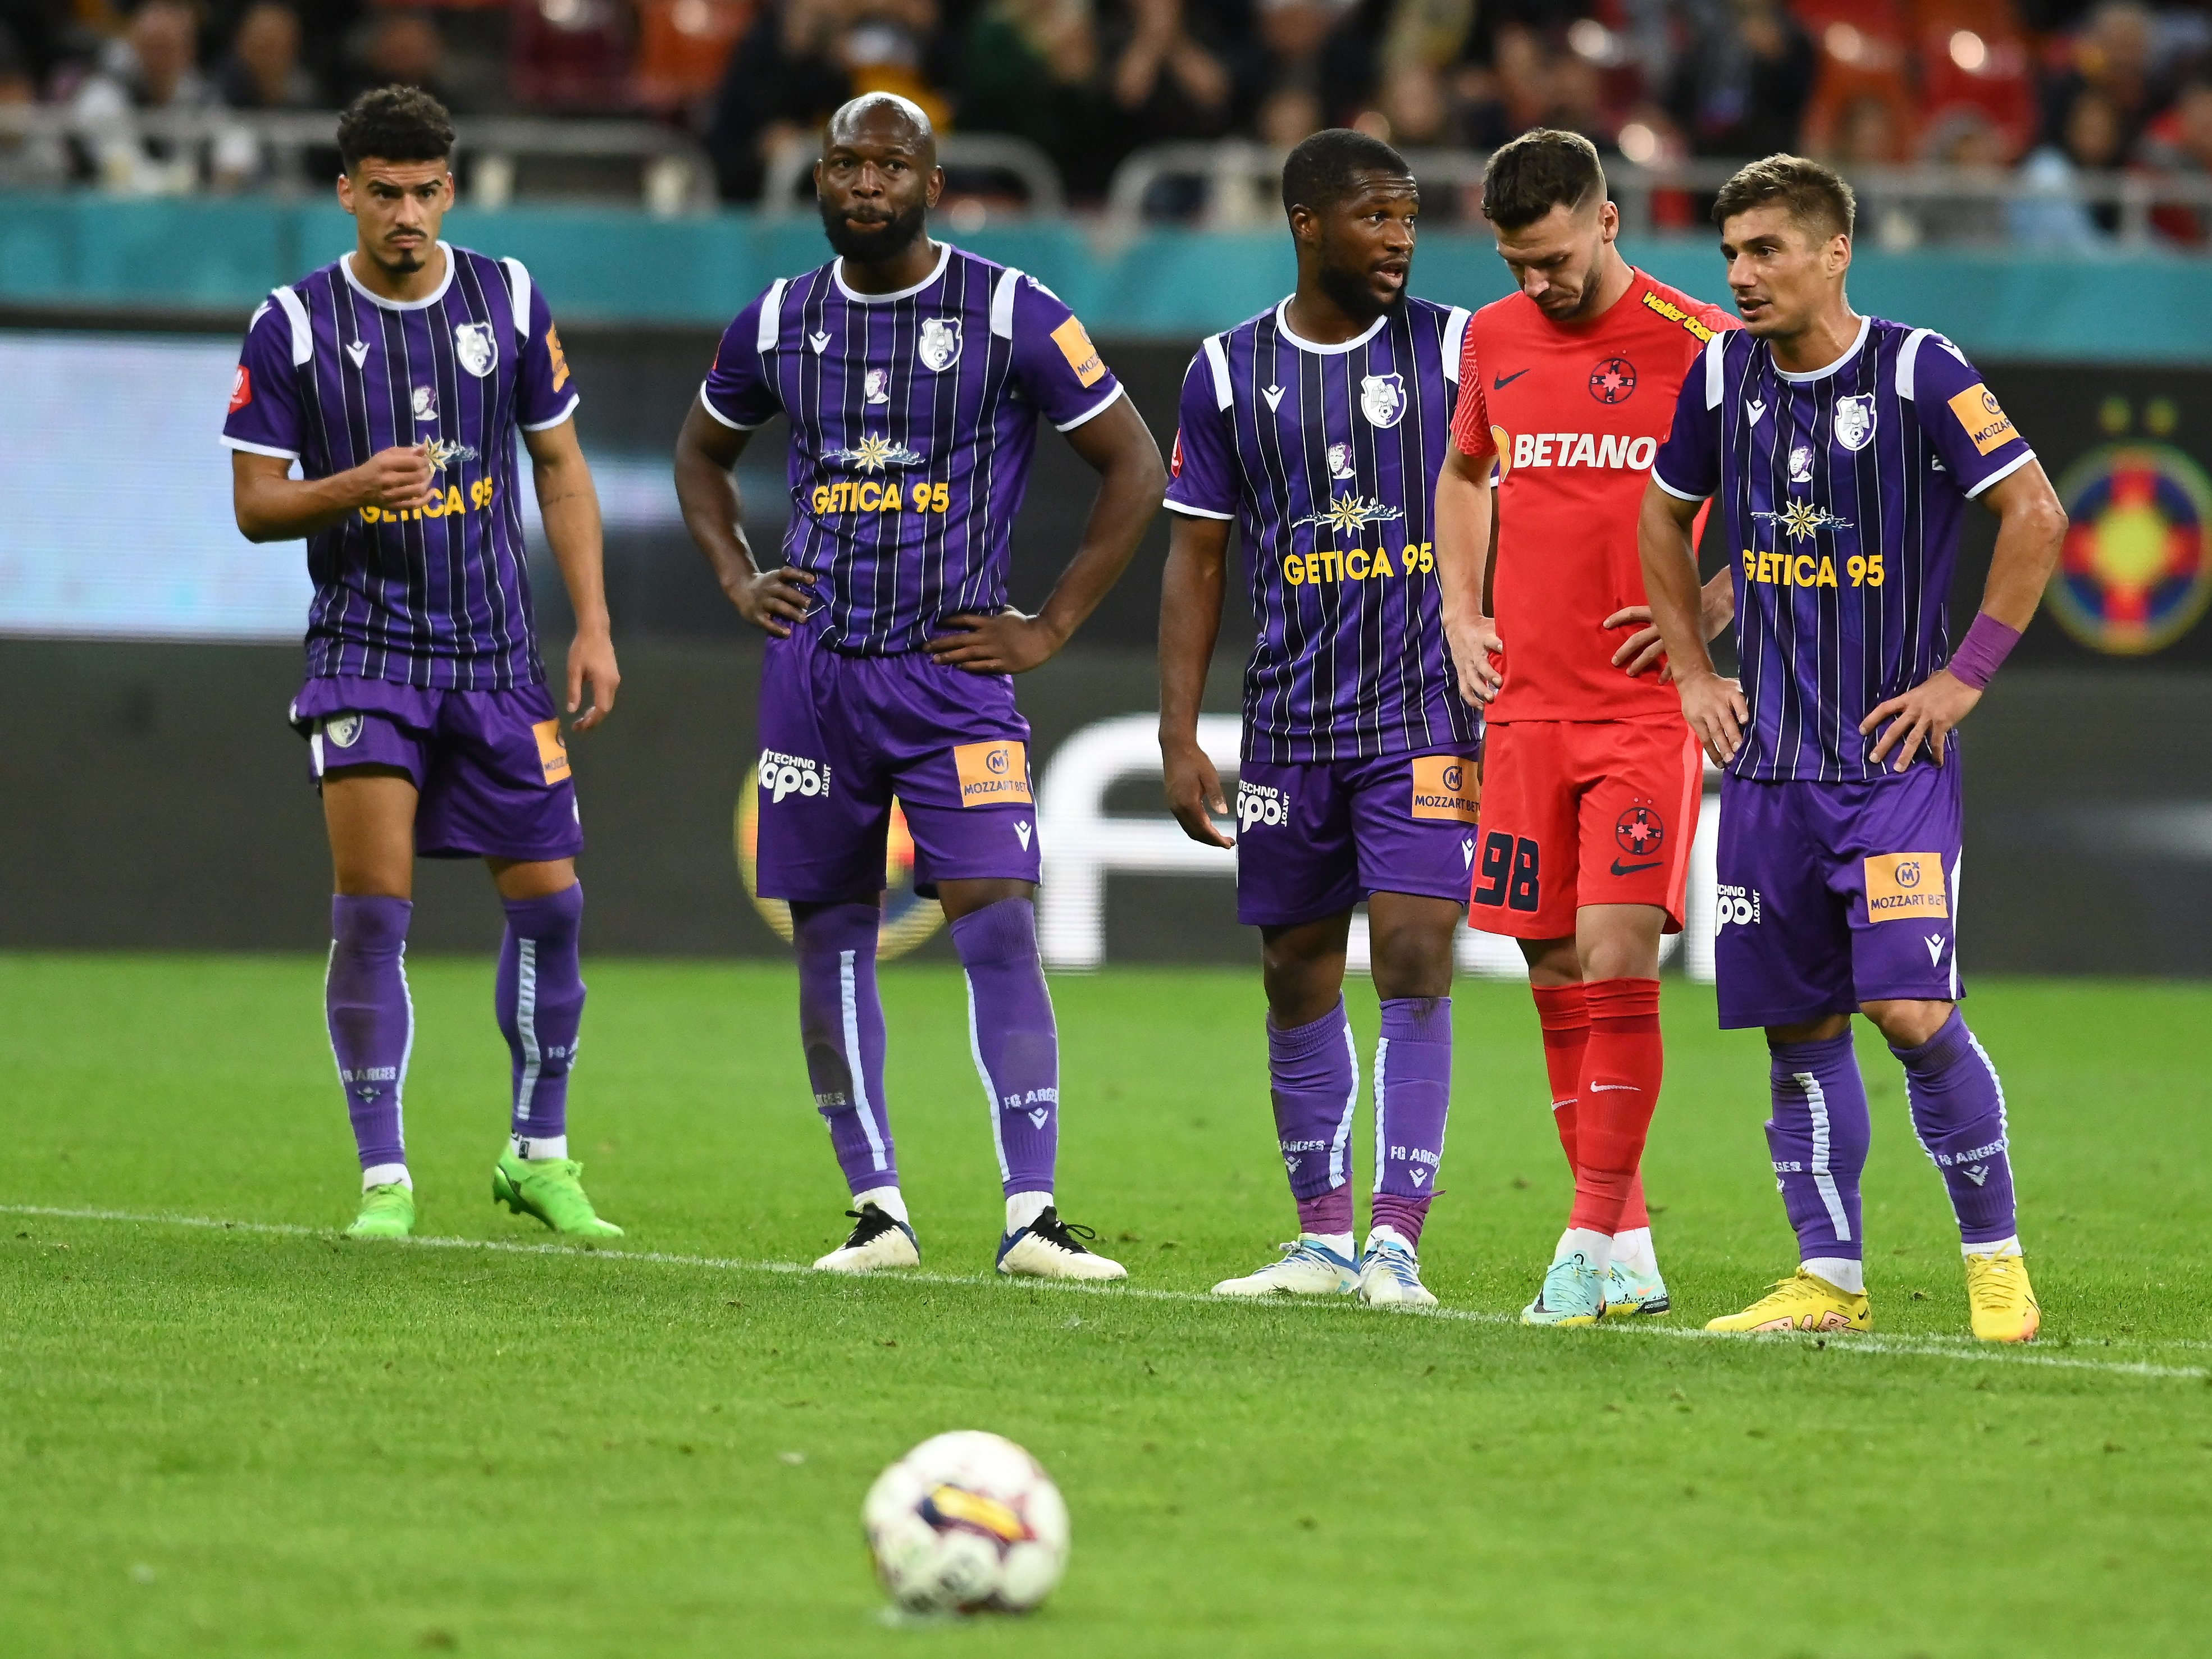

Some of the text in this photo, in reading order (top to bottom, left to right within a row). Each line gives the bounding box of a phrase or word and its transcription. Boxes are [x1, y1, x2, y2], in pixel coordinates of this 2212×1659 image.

[1974, 418, 2012, 444] MOZZAR
[1513, 433, 1657, 470] BETANO
[471, 477, 492, 510] 95
[812, 481, 950, 515] GETICA 95
[1284, 542, 1434, 586] GETICA 95
[1743, 549, 1885, 588] GETICA 95
[768, 751, 816, 770] TECHNO
[1014, 781, 1027, 793] BET
[1239, 779, 1278, 798] TECHNO
[1415, 795, 1466, 810] MOZZART
[1473, 831, 1539, 912] 98
[1871, 894, 1924, 911] MOZZART
